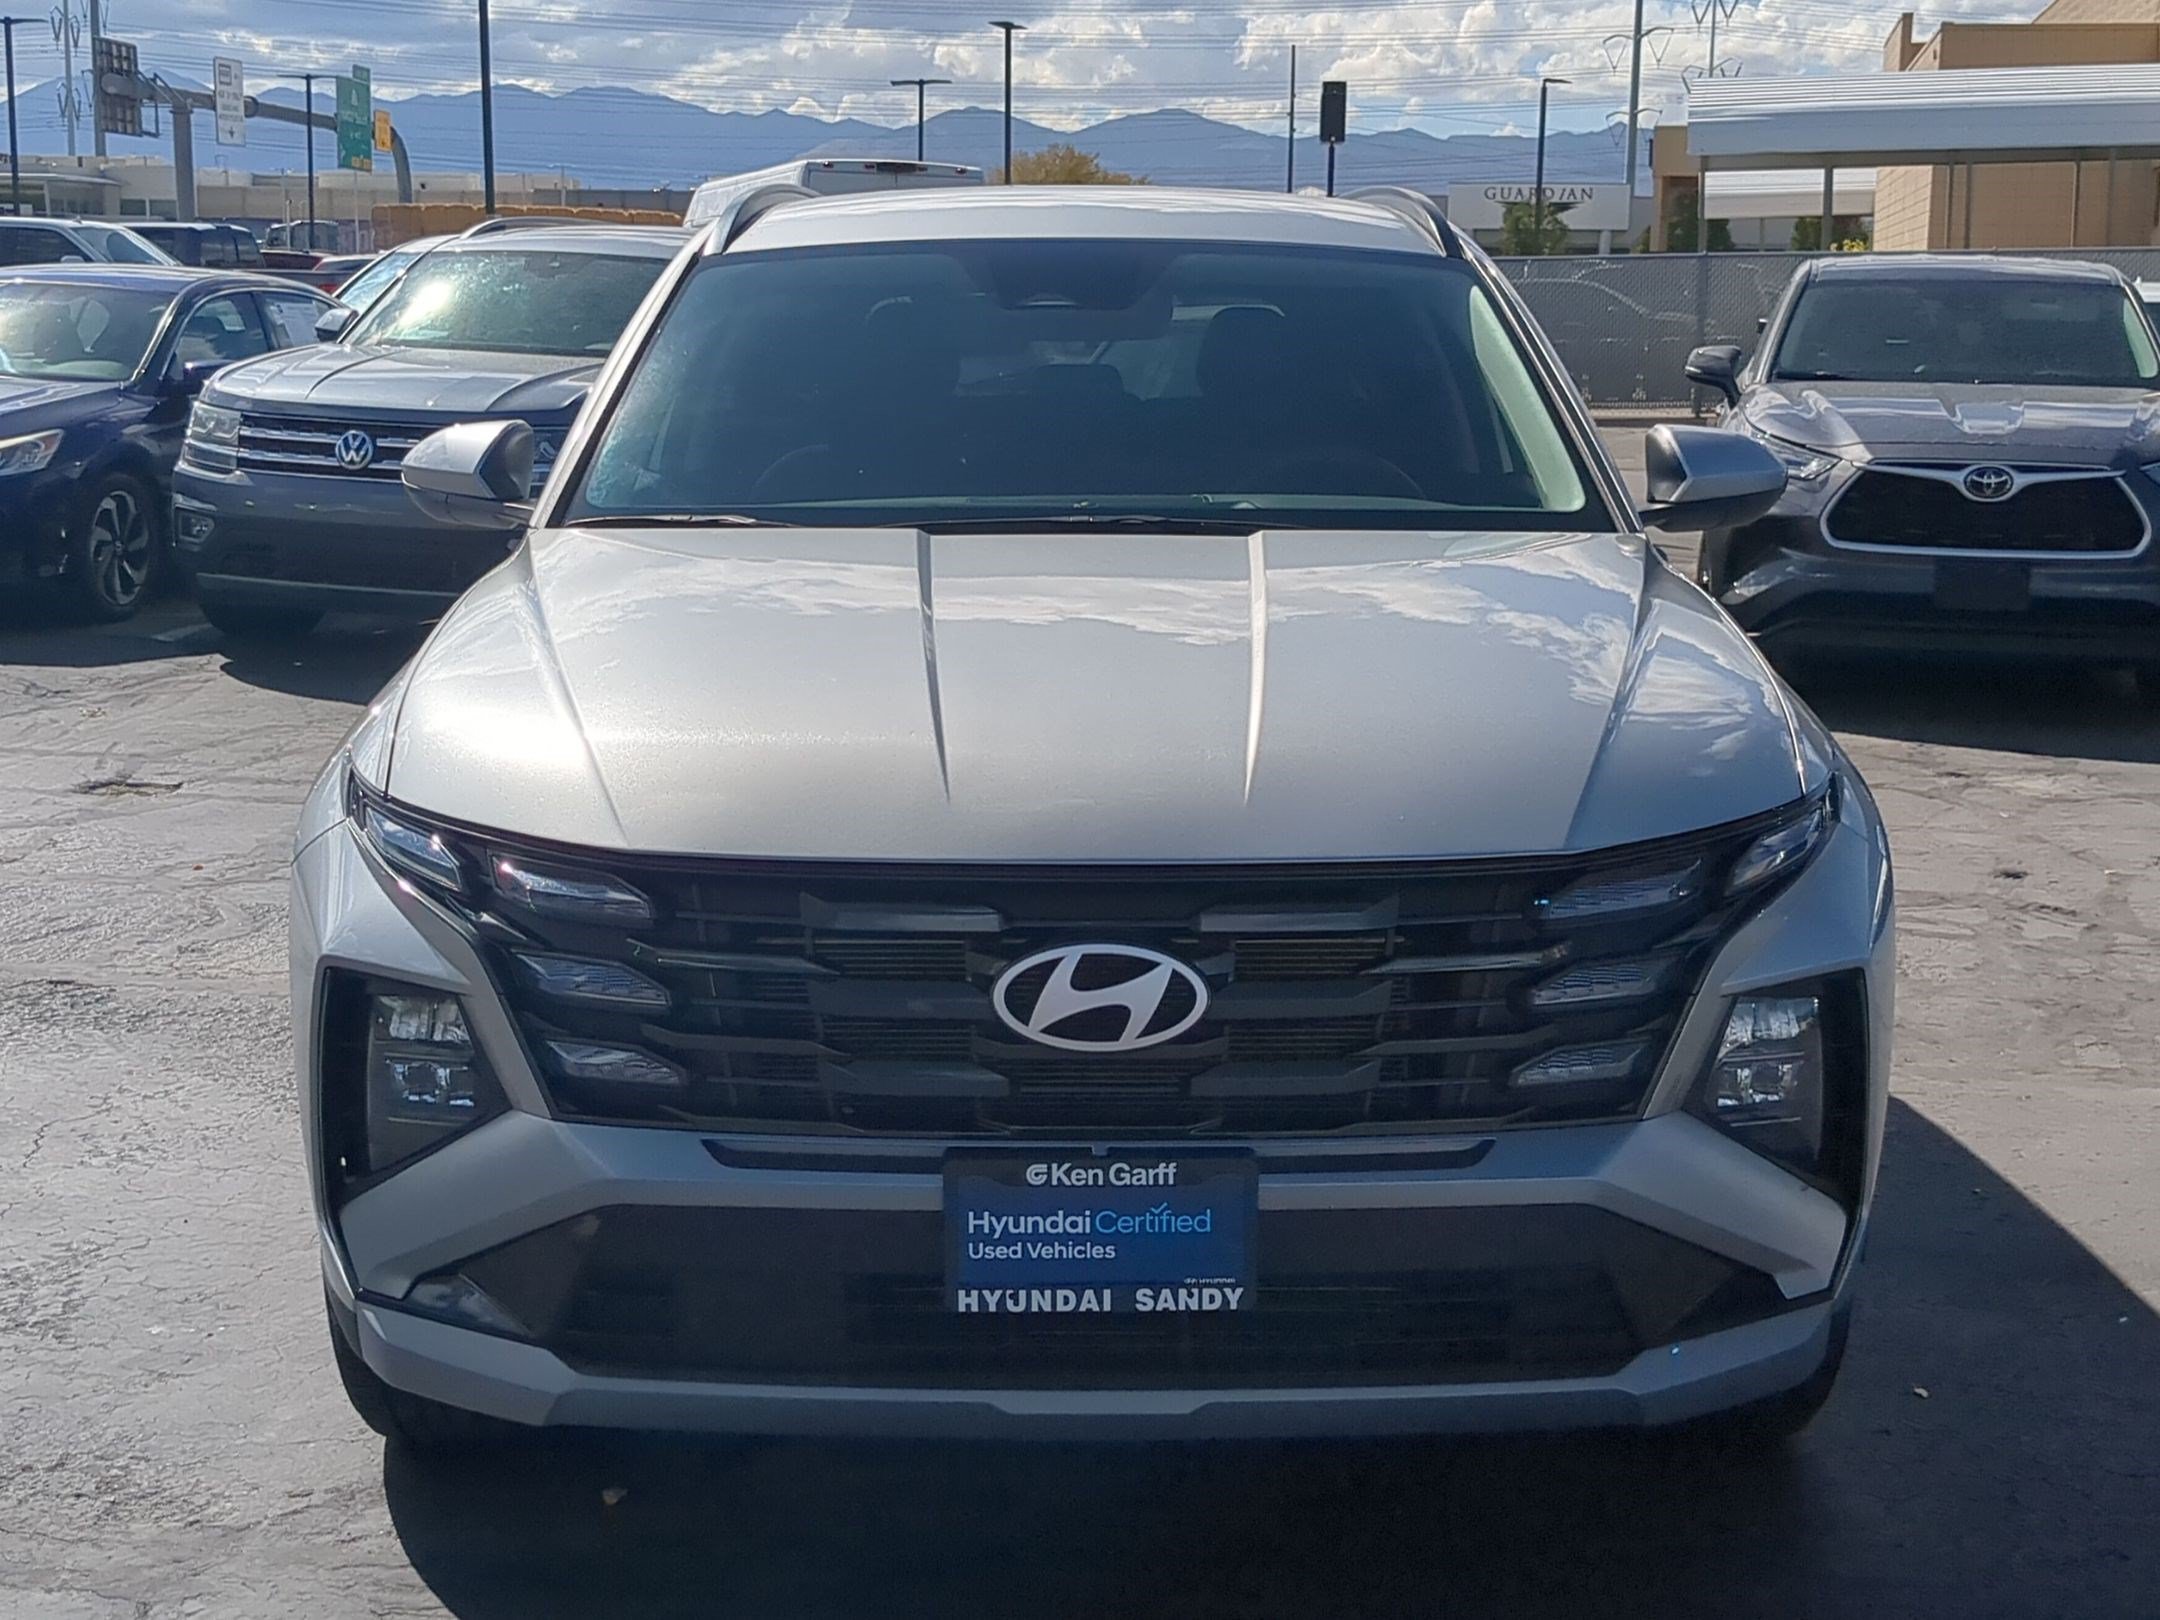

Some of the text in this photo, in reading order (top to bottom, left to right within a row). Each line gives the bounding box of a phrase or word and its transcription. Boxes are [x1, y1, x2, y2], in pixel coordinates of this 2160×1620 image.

[1484, 187, 1594, 201] GUARDIAN
[1051, 1162, 1178, 1186] Ken Garff
[967, 1203, 1212, 1240] Hyundai Certified
[968, 1241, 1116, 1260] Used Vehicles
[957, 1287, 1245, 1313] HYUNDAI SANDY
